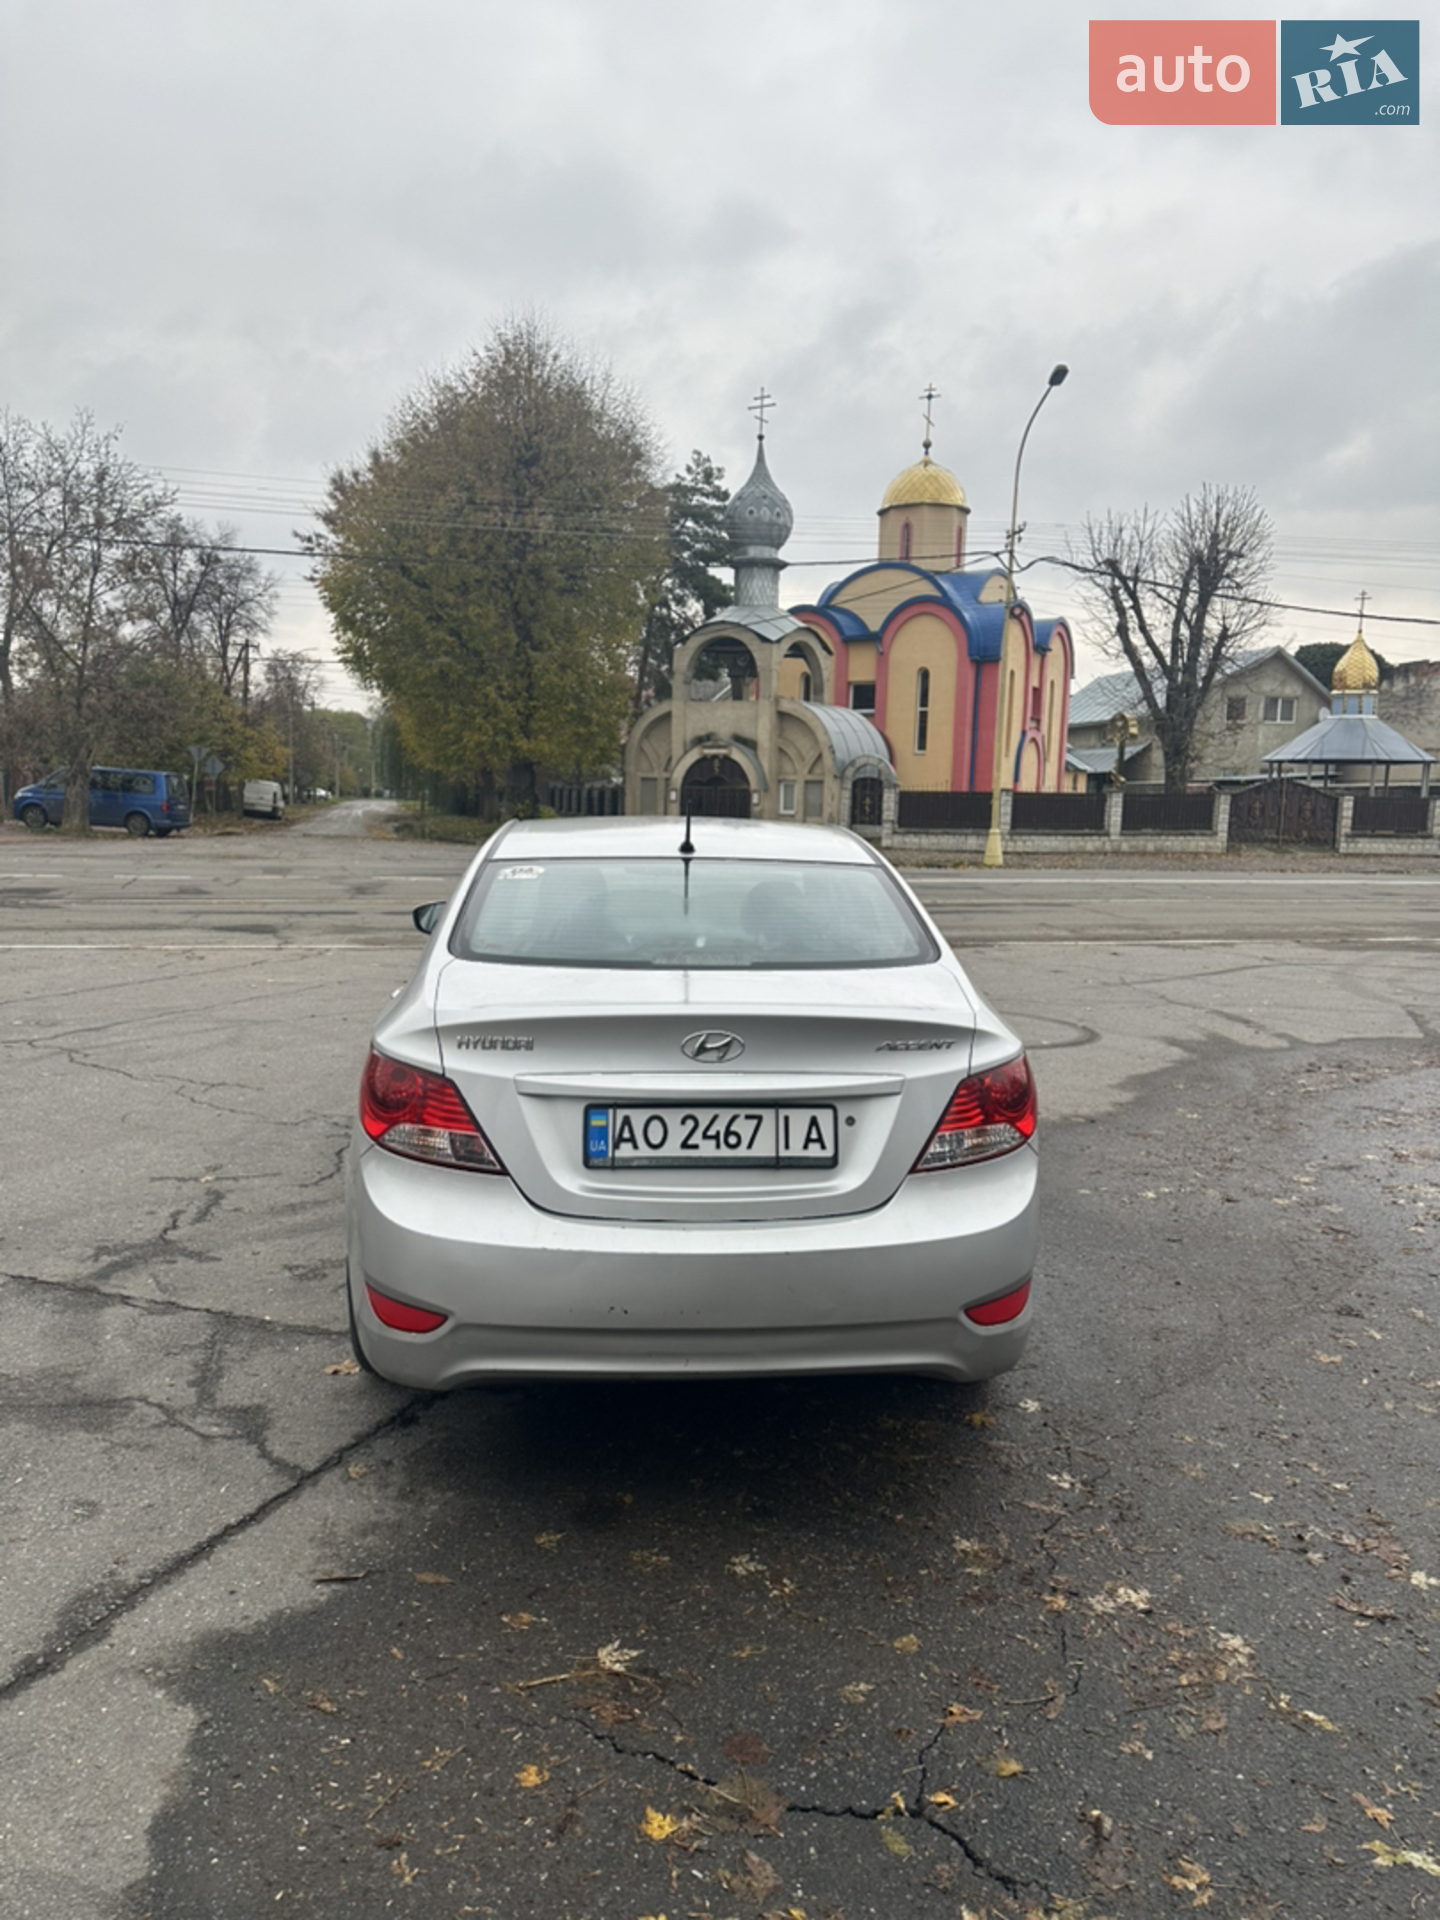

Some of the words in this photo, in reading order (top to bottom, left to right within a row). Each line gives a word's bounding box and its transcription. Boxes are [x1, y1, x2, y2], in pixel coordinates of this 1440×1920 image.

[456, 1035, 534, 1051] HYUNDAI
[876, 1038, 956, 1052] ACCENT
[614, 1114, 669, 1151] AO
[680, 1114, 764, 1151] 2467
[784, 1114, 828, 1151] IA
[590, 1140, 607, 1152] UA
